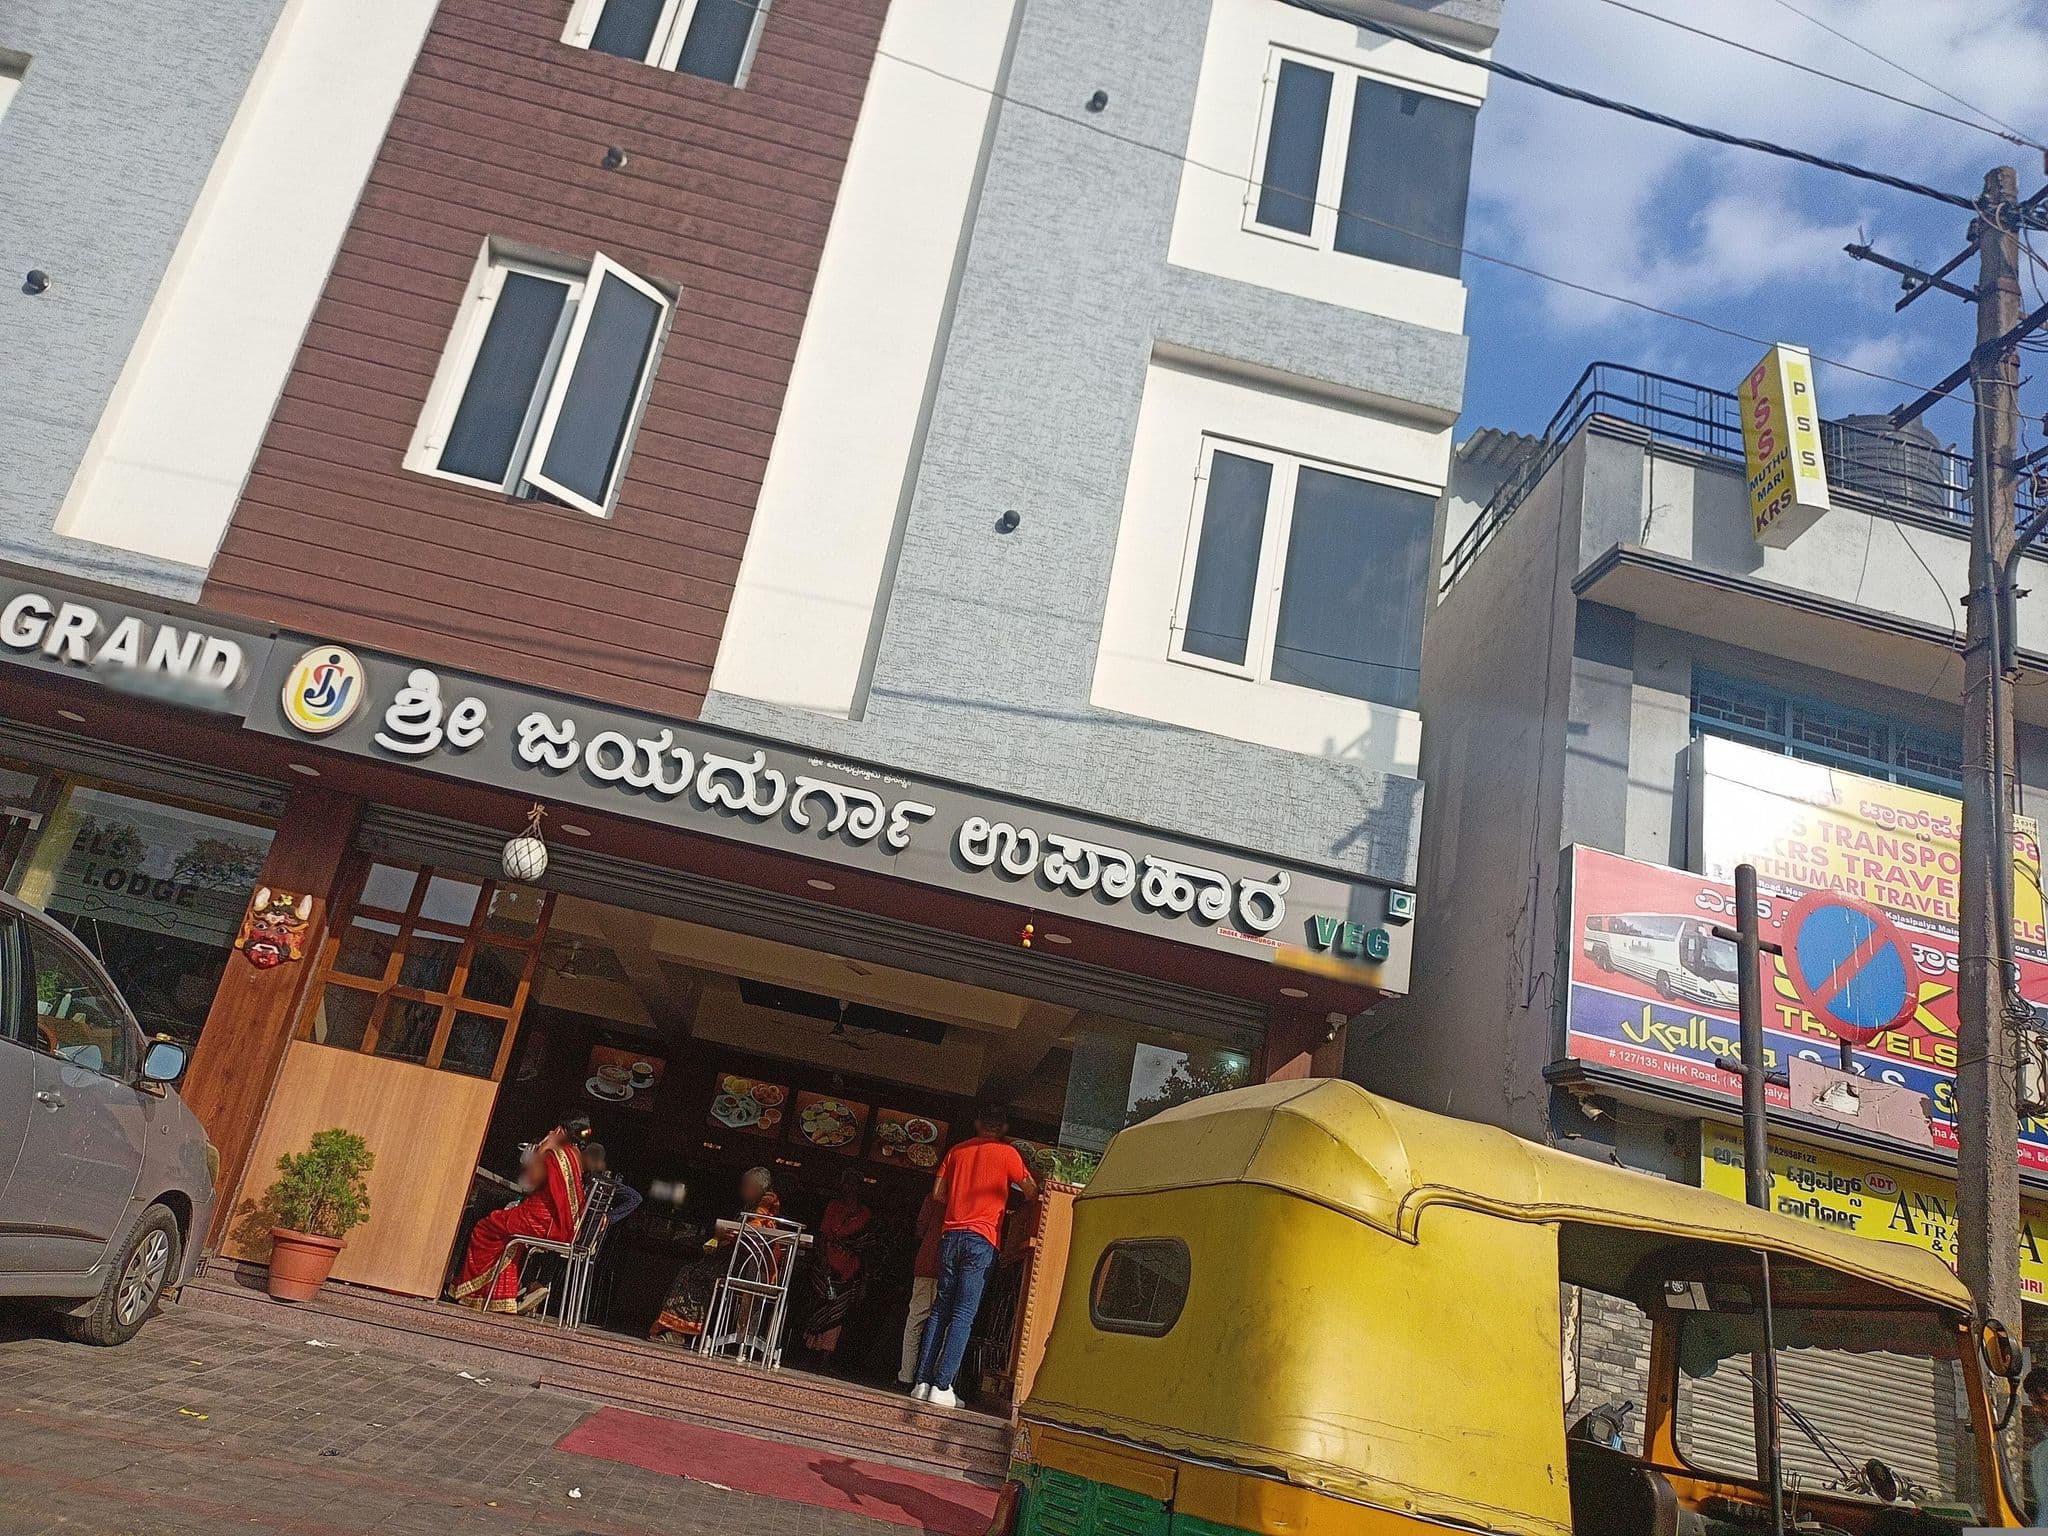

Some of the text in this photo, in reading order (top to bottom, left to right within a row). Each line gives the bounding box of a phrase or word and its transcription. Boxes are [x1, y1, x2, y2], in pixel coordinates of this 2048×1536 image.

[1750, 447, 1789, 492] MUTHU
[1757, 472, 1785, 502] MARI
[1755, 488, 1793, 533] KRS
[0, 593, 243, 690] GRAND
[374, 668, 488, 755] ಶ್ರೀ
[1817, 820, 1961, 875] TRANSPO
[82, 862, 198, 906] LODGE
[1842, 852, 1961, 900] TRAVE
[1874, 883, 1961, 919] TRAVEL
[1307, 914, 1391, 963] VEG
[1775, 1003, 1958, 1068] TRELS
[1663, 1062, 1689, 1077] NHK
[1690, 1068, 1721, 1085] Road,
[1868, 1175, 1895, 1191] ADT
